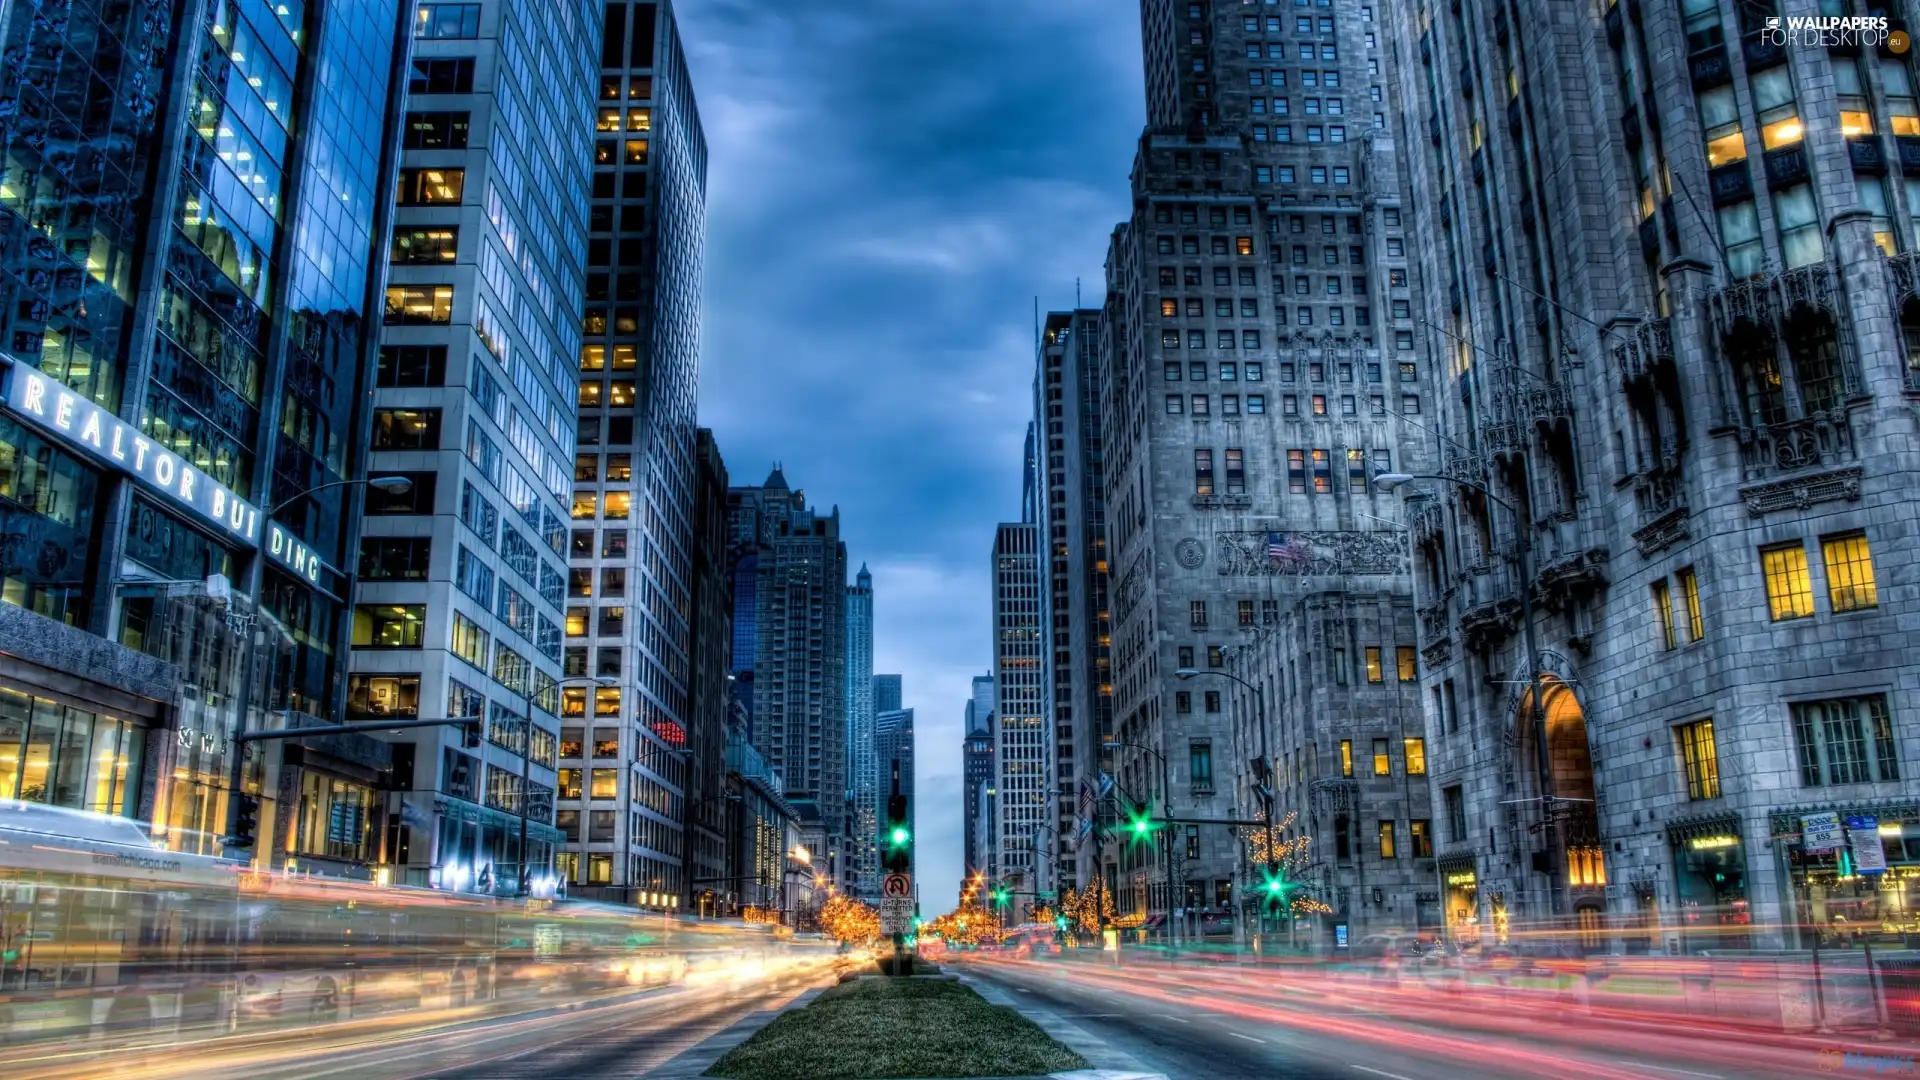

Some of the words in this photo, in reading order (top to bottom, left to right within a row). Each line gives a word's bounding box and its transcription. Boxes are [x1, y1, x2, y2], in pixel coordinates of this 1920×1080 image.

[23, 373, 195, 502] REALTOR
[211, 490, 321, 582] BUIDING
[1815, 832, 1831, 841] 855
